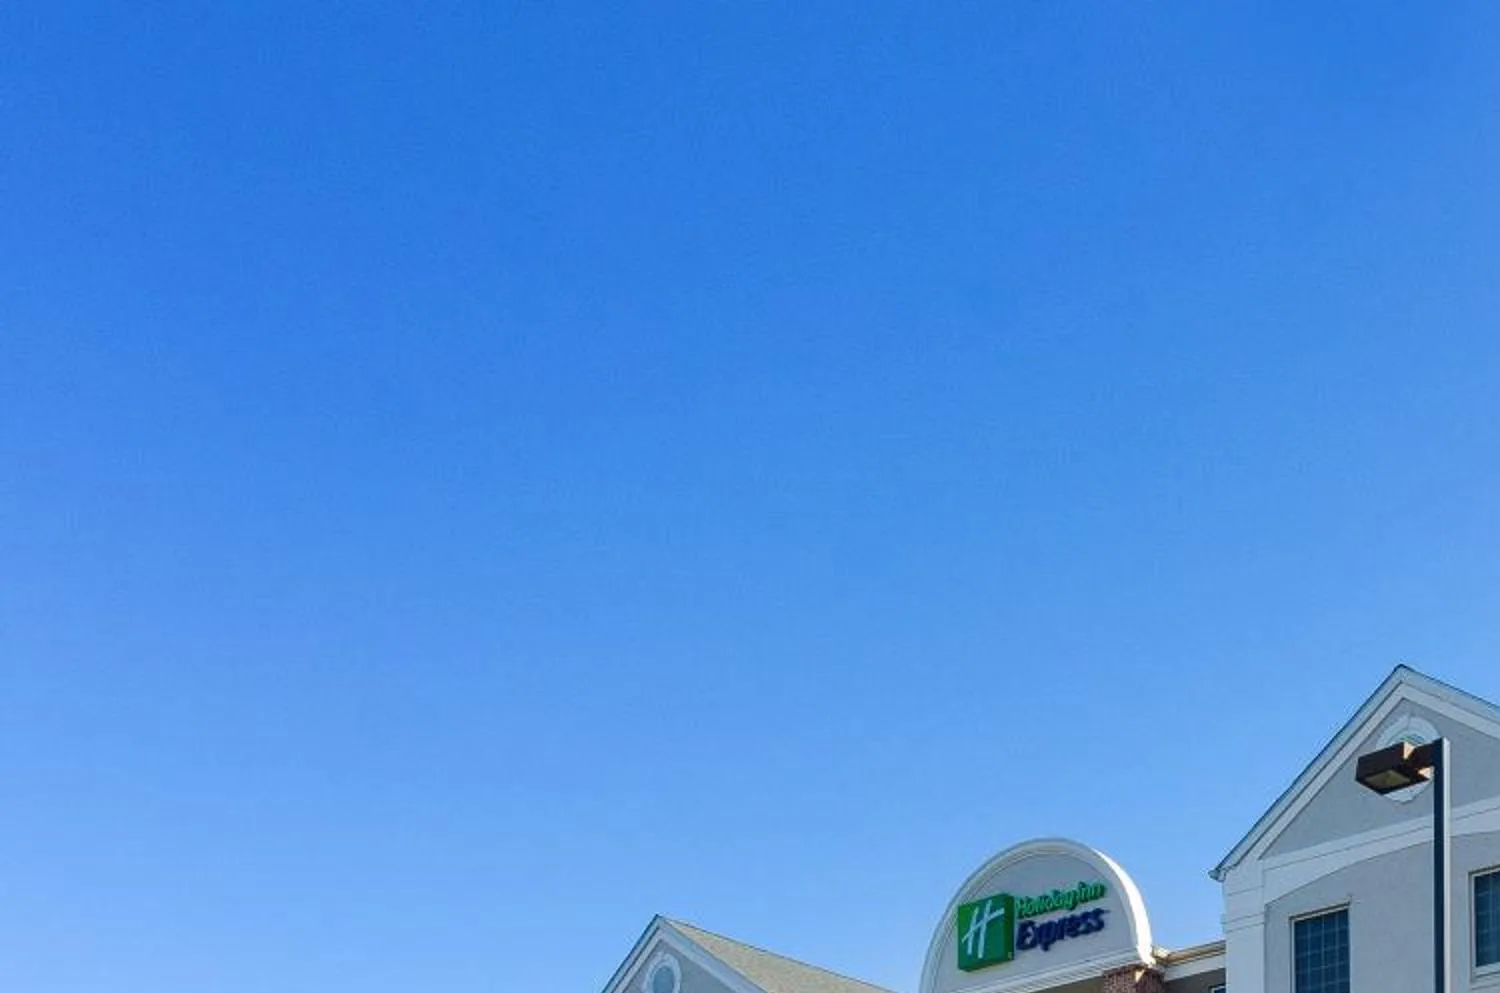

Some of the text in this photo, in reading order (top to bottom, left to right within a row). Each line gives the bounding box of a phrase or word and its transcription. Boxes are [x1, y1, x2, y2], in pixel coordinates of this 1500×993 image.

[1016, 881, 1106, 919] Holiday Inn
[1016, 908, 1111, 952] Express
